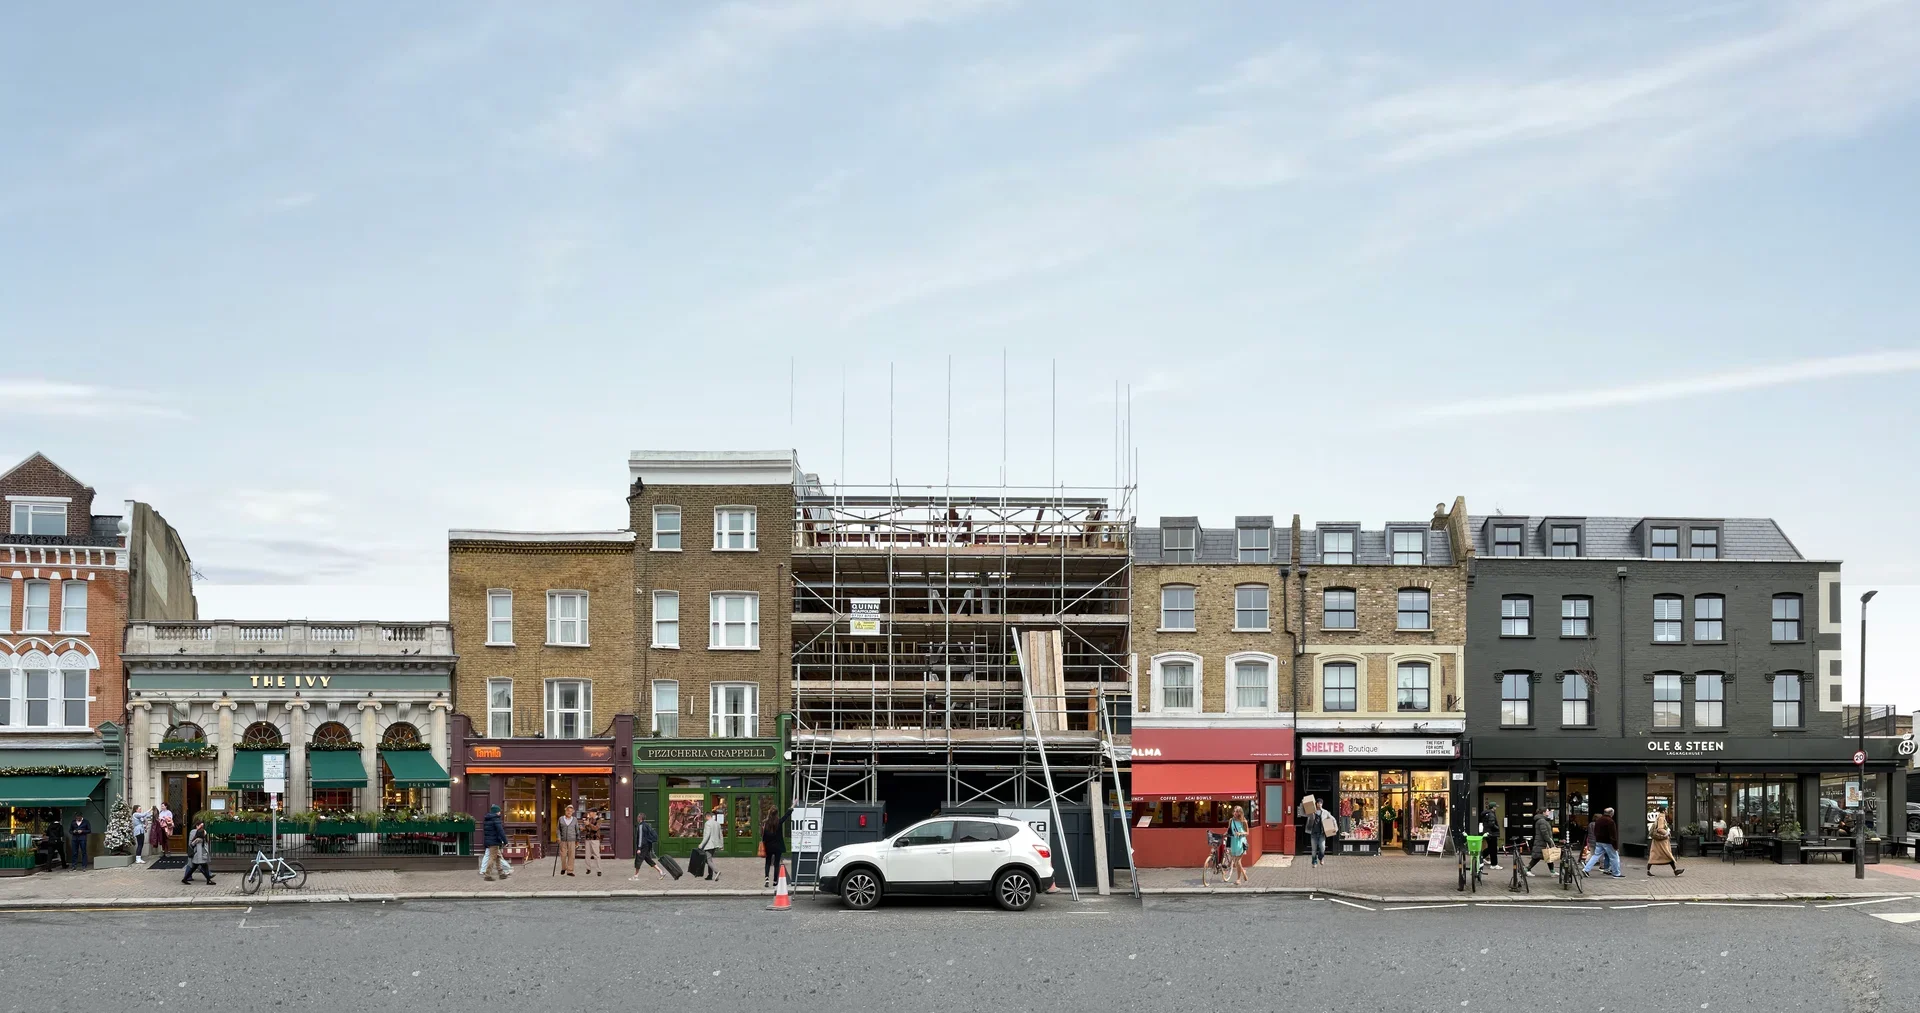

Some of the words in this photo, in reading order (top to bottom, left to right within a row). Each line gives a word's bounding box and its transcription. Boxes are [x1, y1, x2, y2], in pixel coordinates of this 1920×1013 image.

[250, 675, 286, 688] THE
[295, 675, 331, 688] IVY
[1306, 742, 1345, 753] SHELTER
[1348, 745, 1378, 754] Boutique
[1647, 741, 1671, 751] OLE
[1674, 741, 1682, 751] &
[1686, 741, 1724, 751] STEEN
[710, 749, 766, 758] GRAPPELLI
[1131, 748, 1162, 756] ALMA
